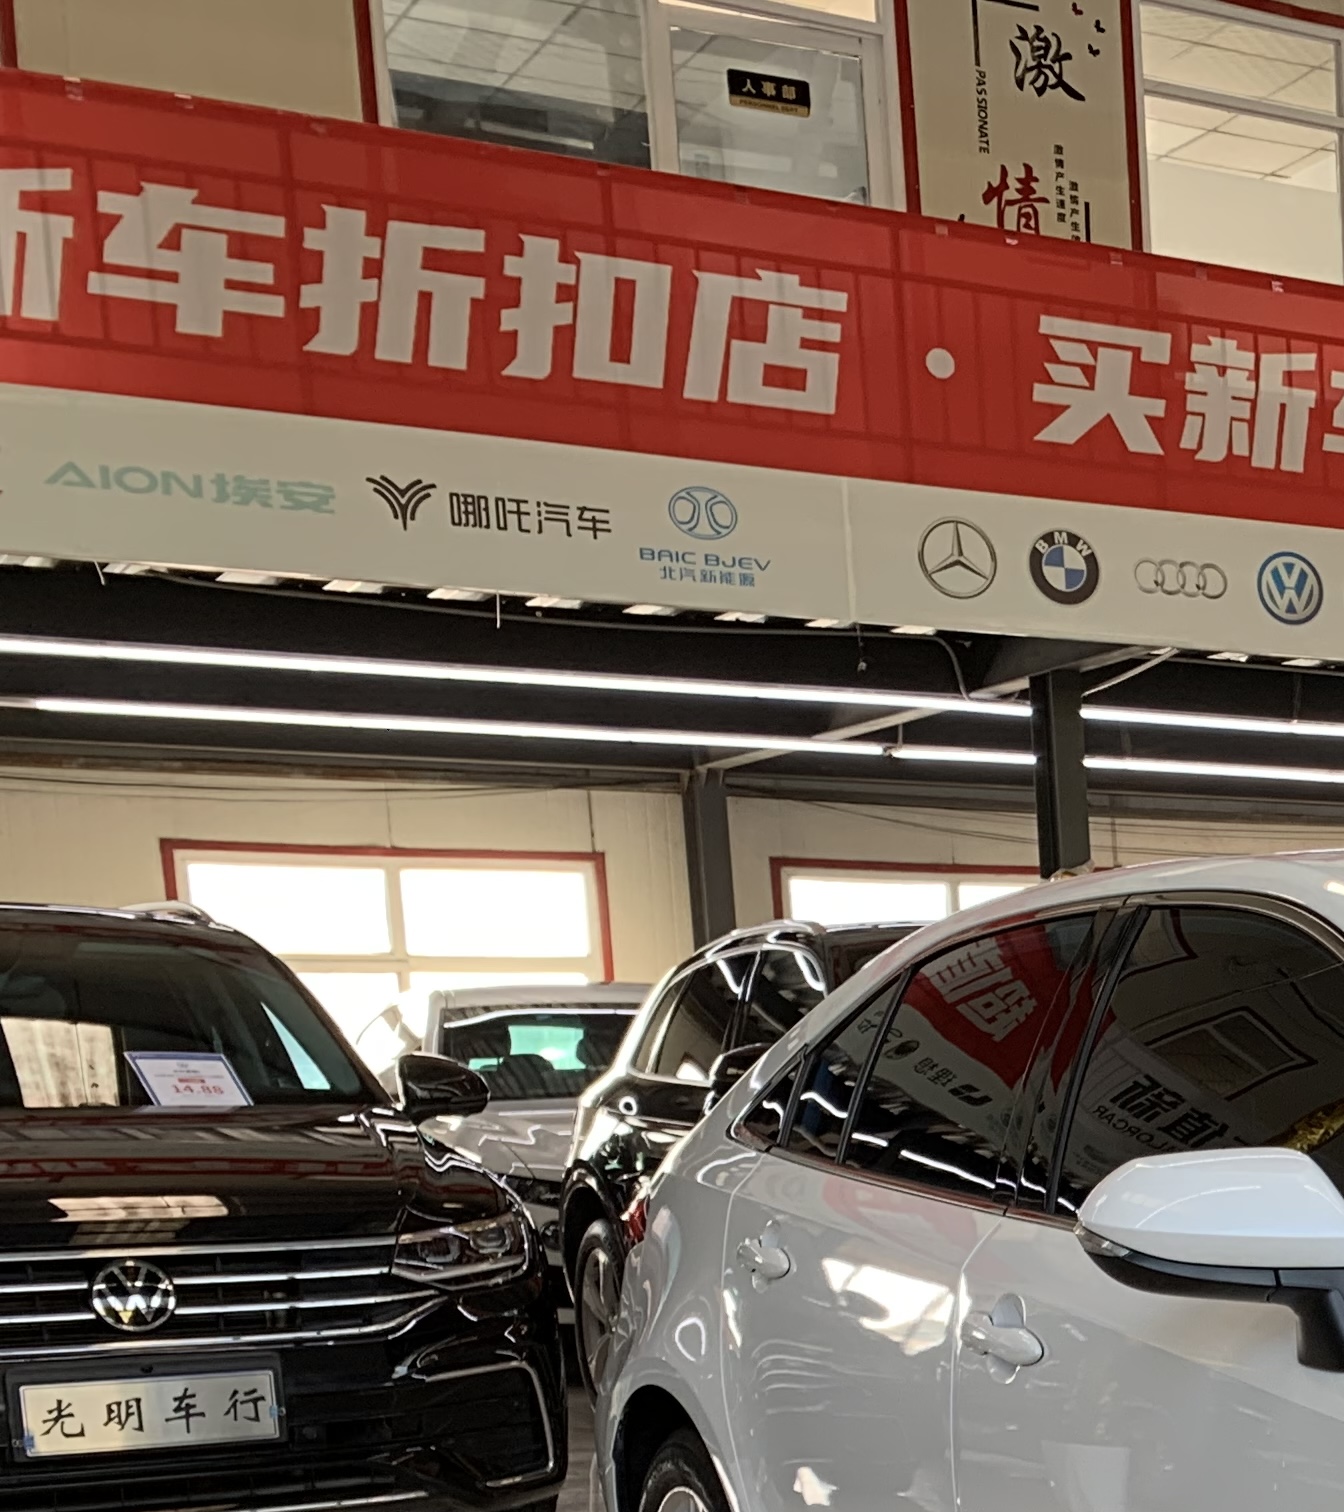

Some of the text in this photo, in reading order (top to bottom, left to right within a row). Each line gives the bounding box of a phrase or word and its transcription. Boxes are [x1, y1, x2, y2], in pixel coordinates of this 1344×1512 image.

[741, 78, 797, 100] 人事部
[975, 69, 990, 154] PASSIONATE
[44, 461, 204, 499] AION
[1034, 531, 1092, 558] BMW
[638, 547, 771, 573] BAIC BJEV
[659, 565, 756, 588] 北汽新能源
[40, 1387, 267, 1438] 光明车行
